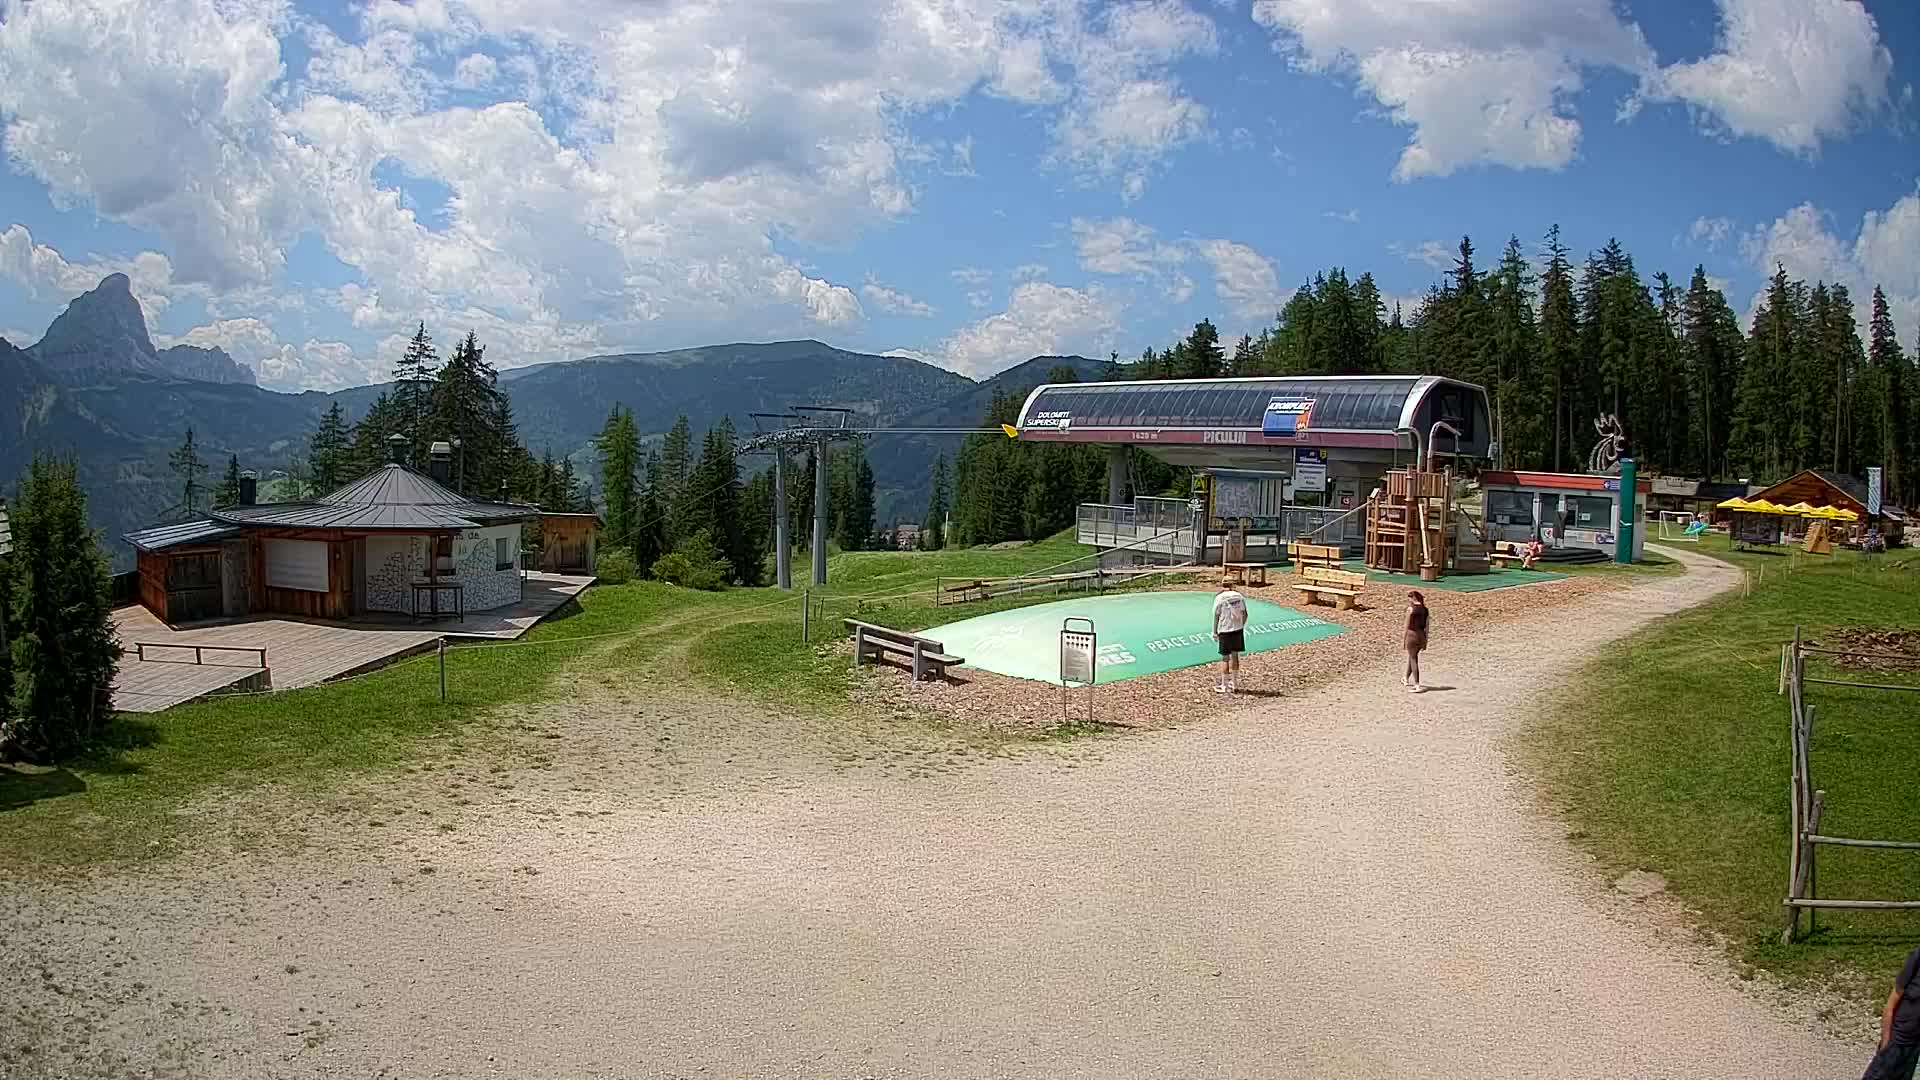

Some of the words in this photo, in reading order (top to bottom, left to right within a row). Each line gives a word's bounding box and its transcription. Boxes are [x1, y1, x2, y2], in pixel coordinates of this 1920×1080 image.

[1037, 411, 1070, 419] DOLOMITI
[1026, 418, 1059, 426] SUPERSKI
[1203, 431, 1247, 444] PICULIN
[1146, 636, 1189, 652] PEACE
[1189, 633, 1206, 643] OF
[1249, 623, 1271, 634] ALL
